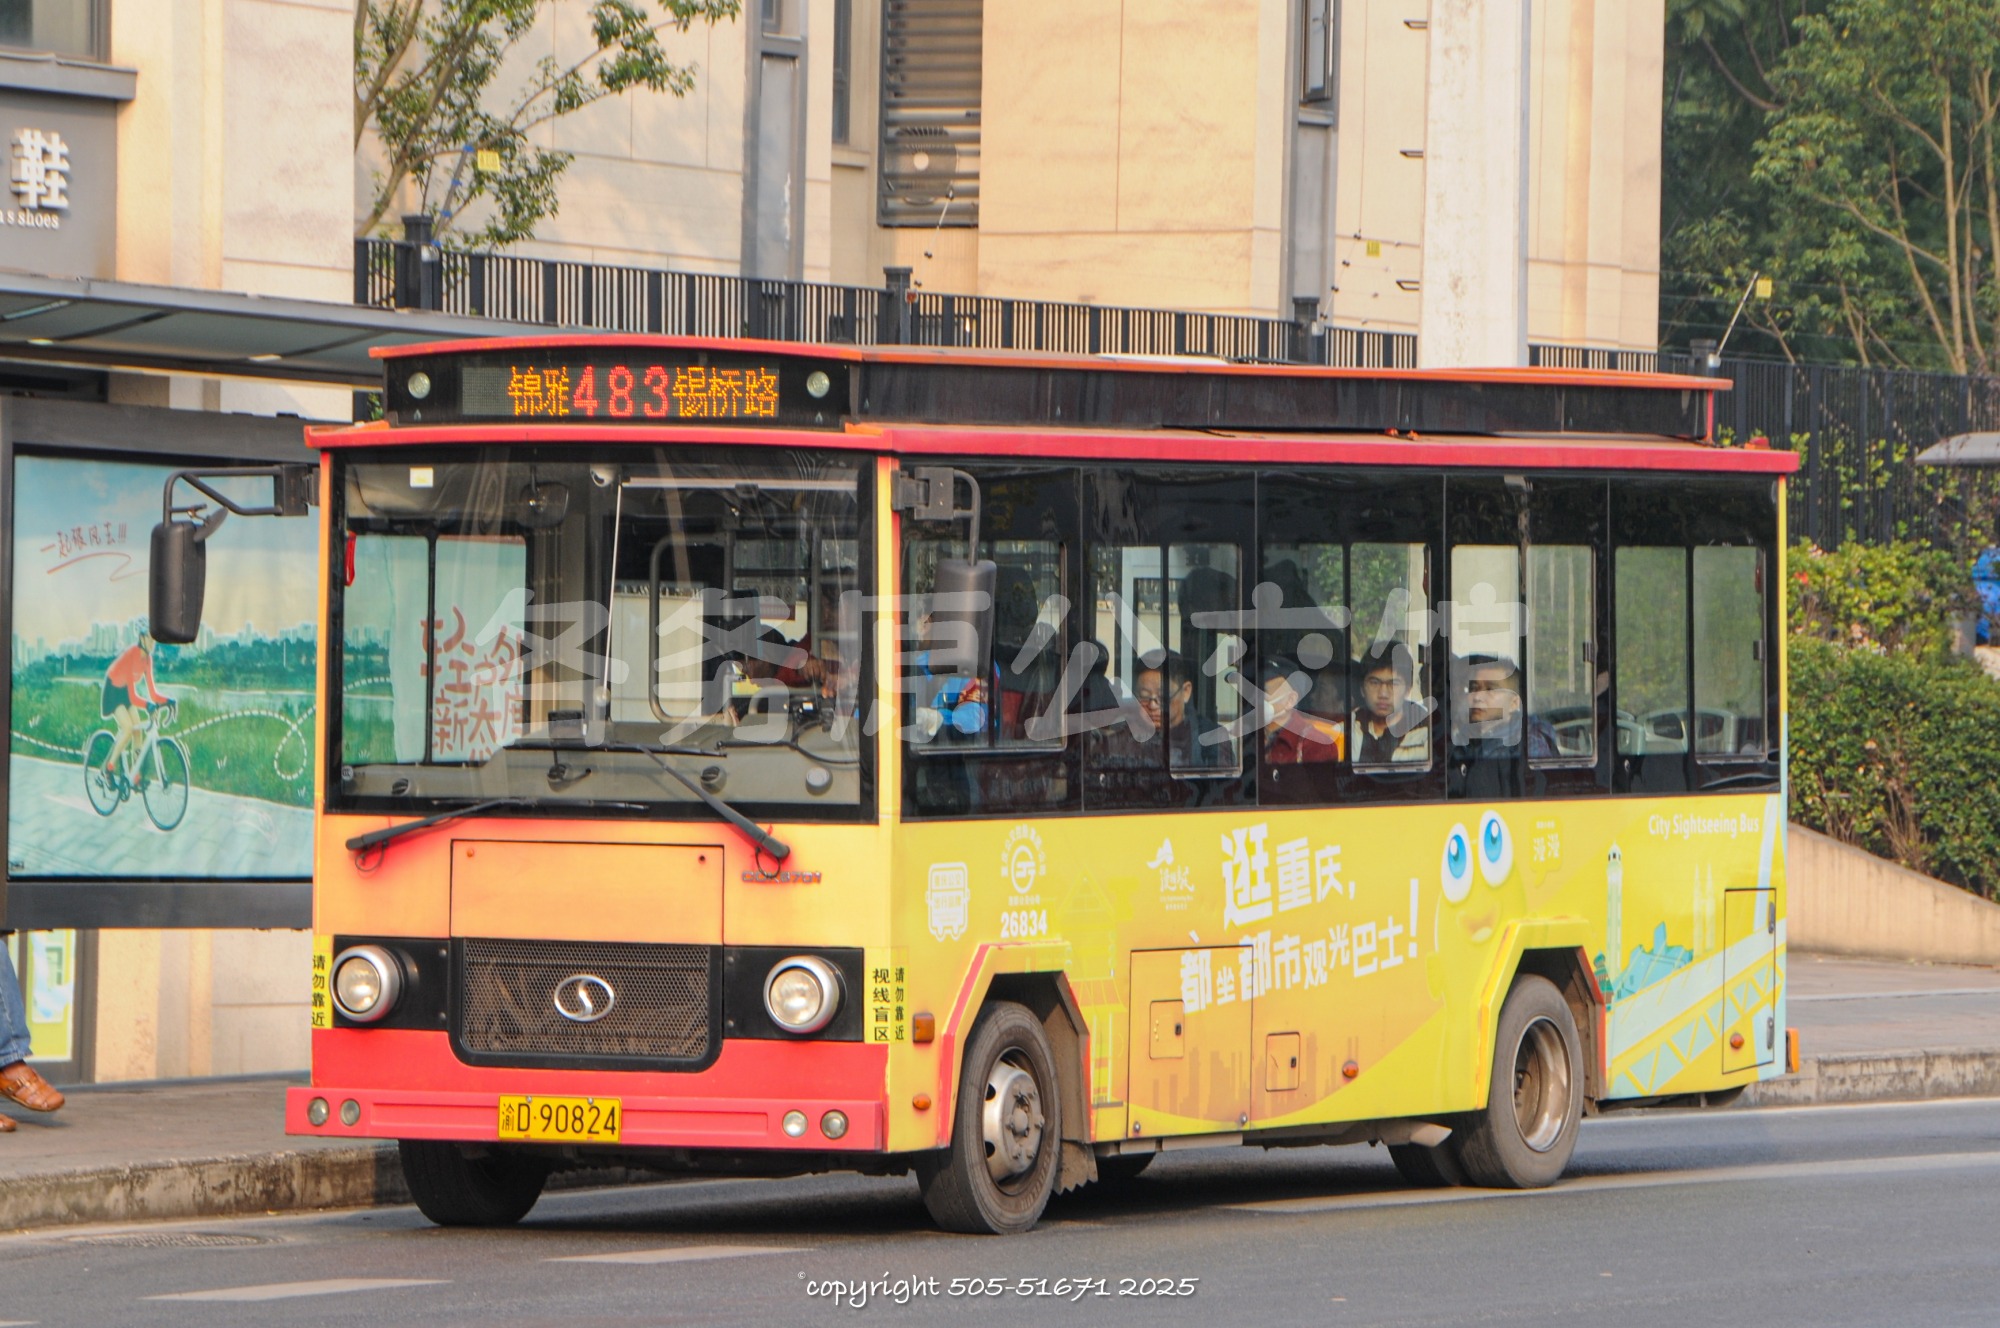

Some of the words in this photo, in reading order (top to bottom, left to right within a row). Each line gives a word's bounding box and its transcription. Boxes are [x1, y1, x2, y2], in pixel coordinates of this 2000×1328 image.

[10, 128, 70, 209] 鞋
[18, 209, 60, 230] shoes
[573, 365, 670, 416] 483
[672, 367, 778, 417] 锡桥路
[1648, 815, 1670, 840] City
[1673, 814, 1737, 840] Sightseeing
[1740, 813, 1759, 833] Bus
[1000, 909, 1048, 939] 26834
[312, 955, 325, 1027] 请勿靠近
[872, 968, 891, 1042] 视线盲区
[895, 967, 904, 1041] 请勿靠近
